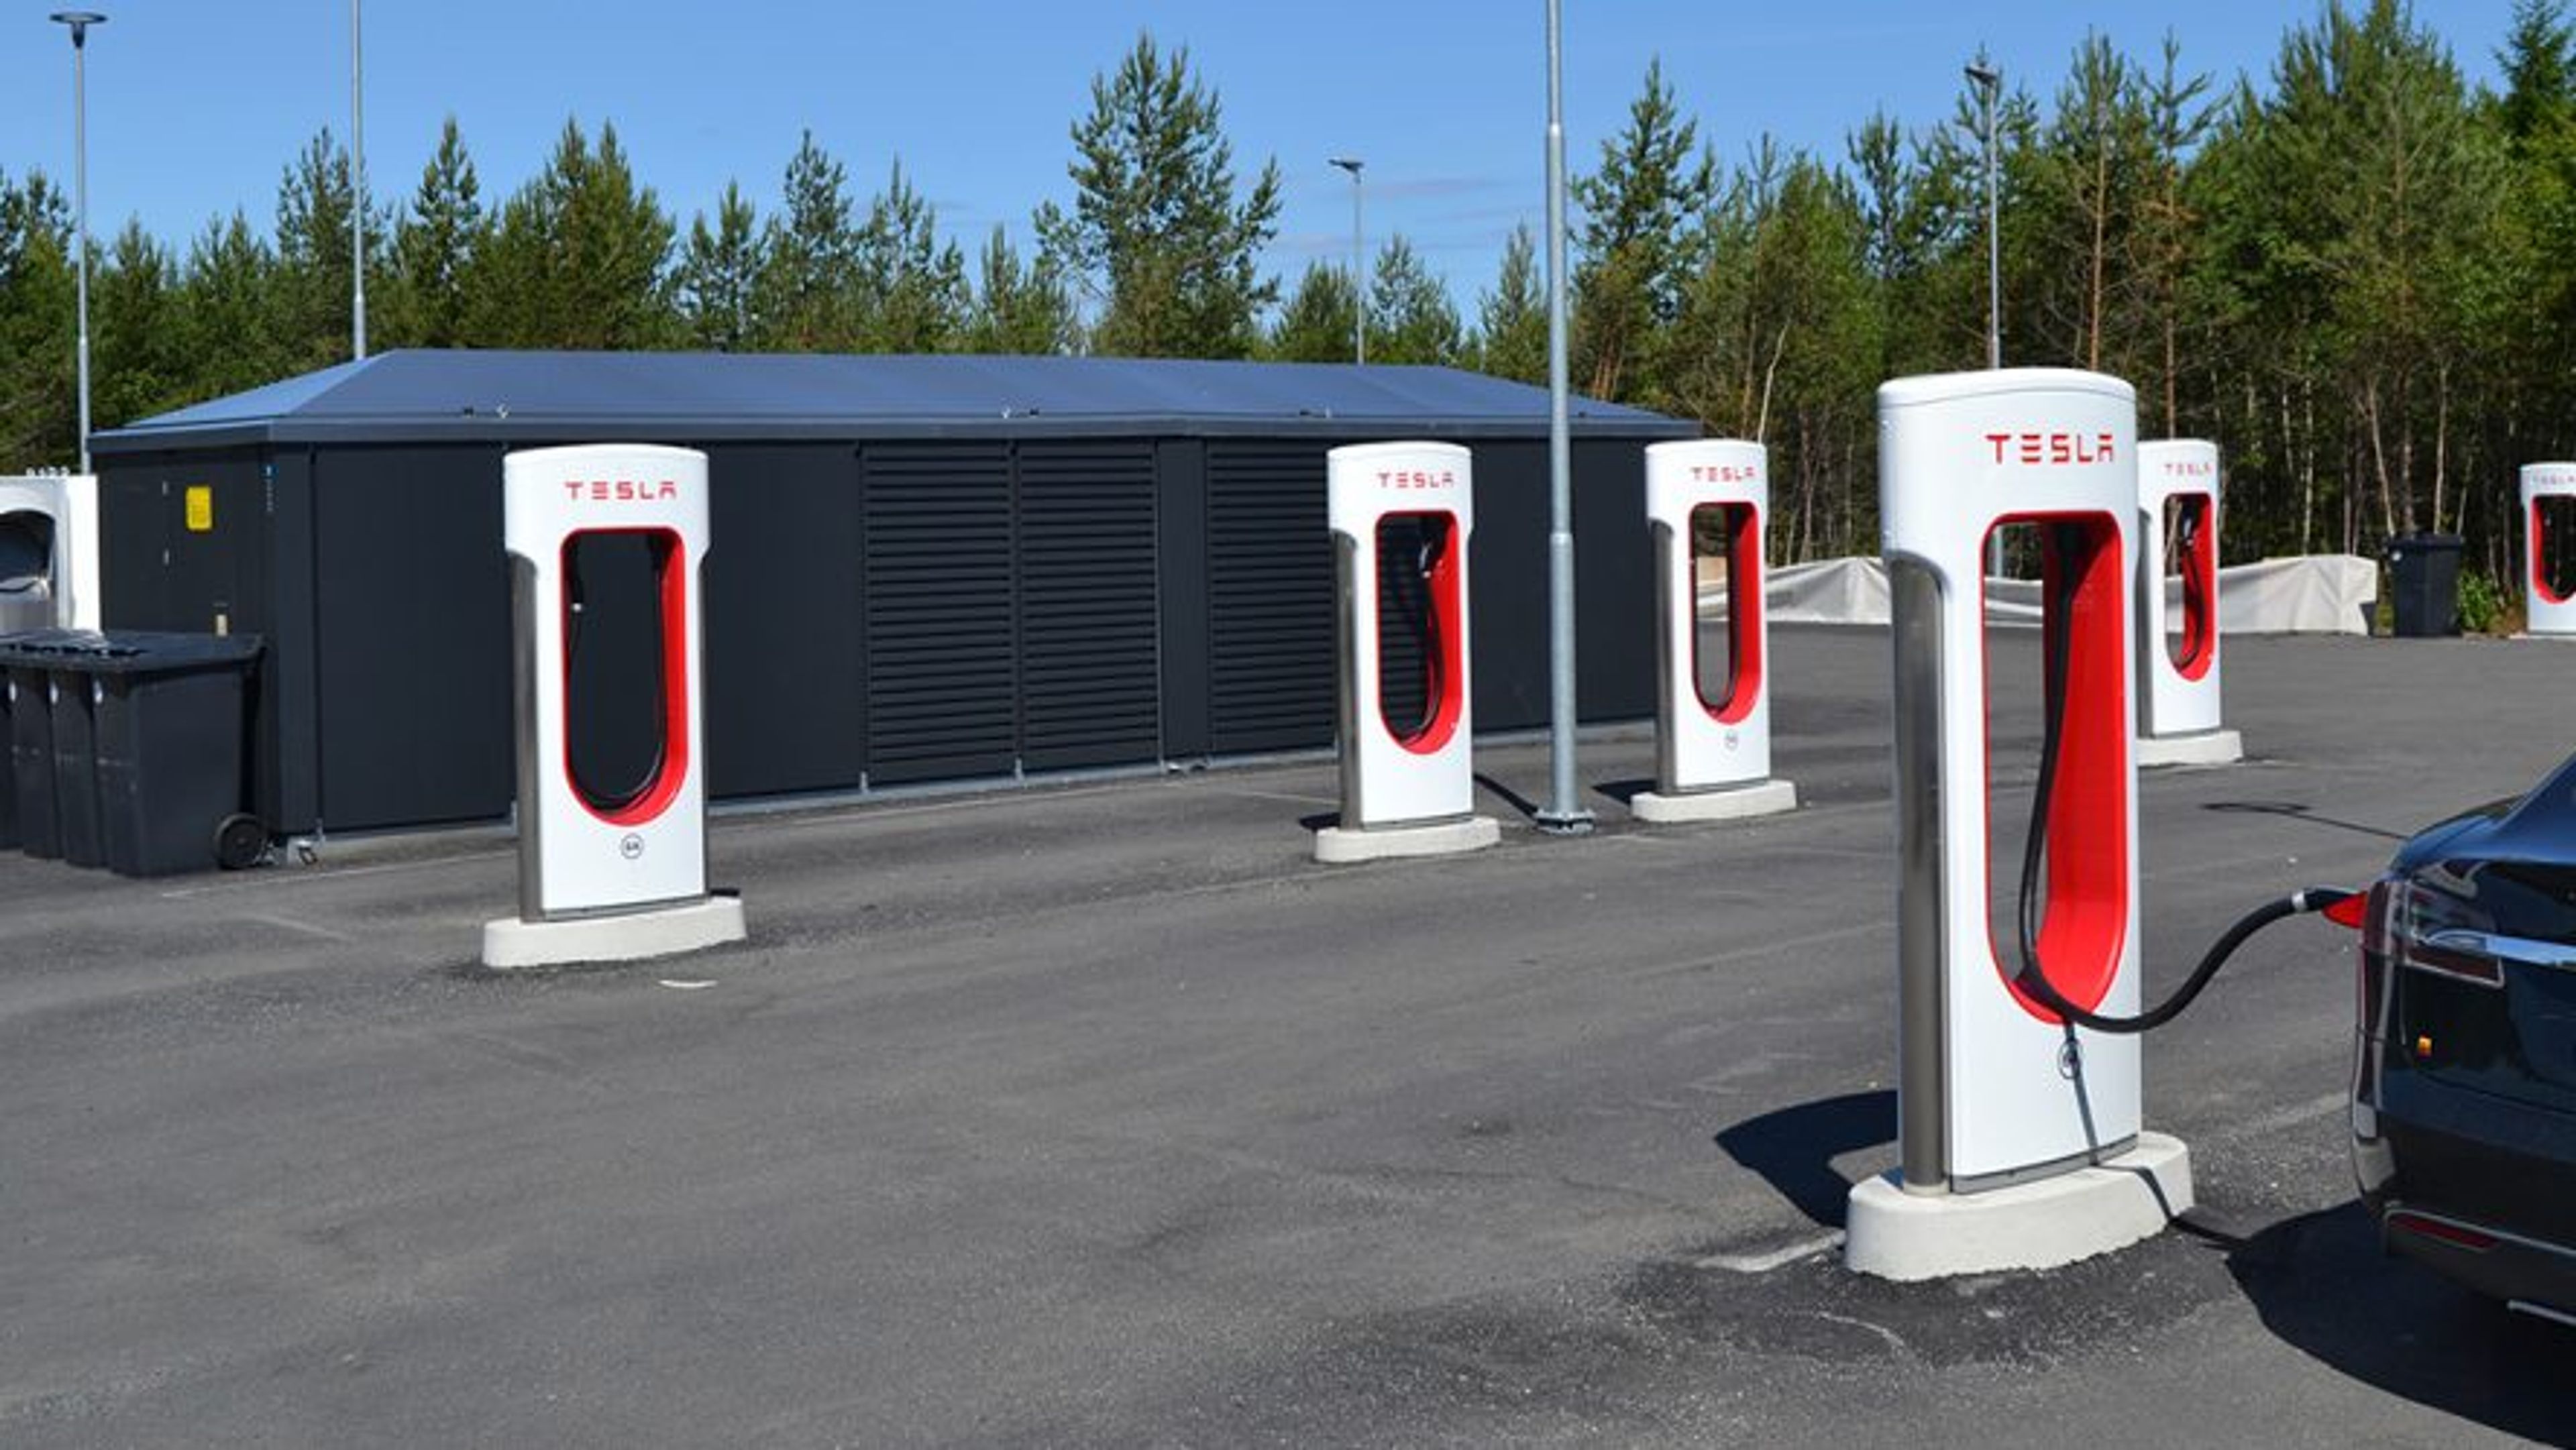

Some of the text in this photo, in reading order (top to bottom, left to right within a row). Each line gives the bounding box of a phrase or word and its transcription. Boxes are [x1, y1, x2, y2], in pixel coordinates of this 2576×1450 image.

[1985, 434, 2113, 463] TESLA
[1377, 472, 1454, 488] TESLA
[1690, 467, 1754, 482] TESLA
[564, 481, 677, 500] TESLA
